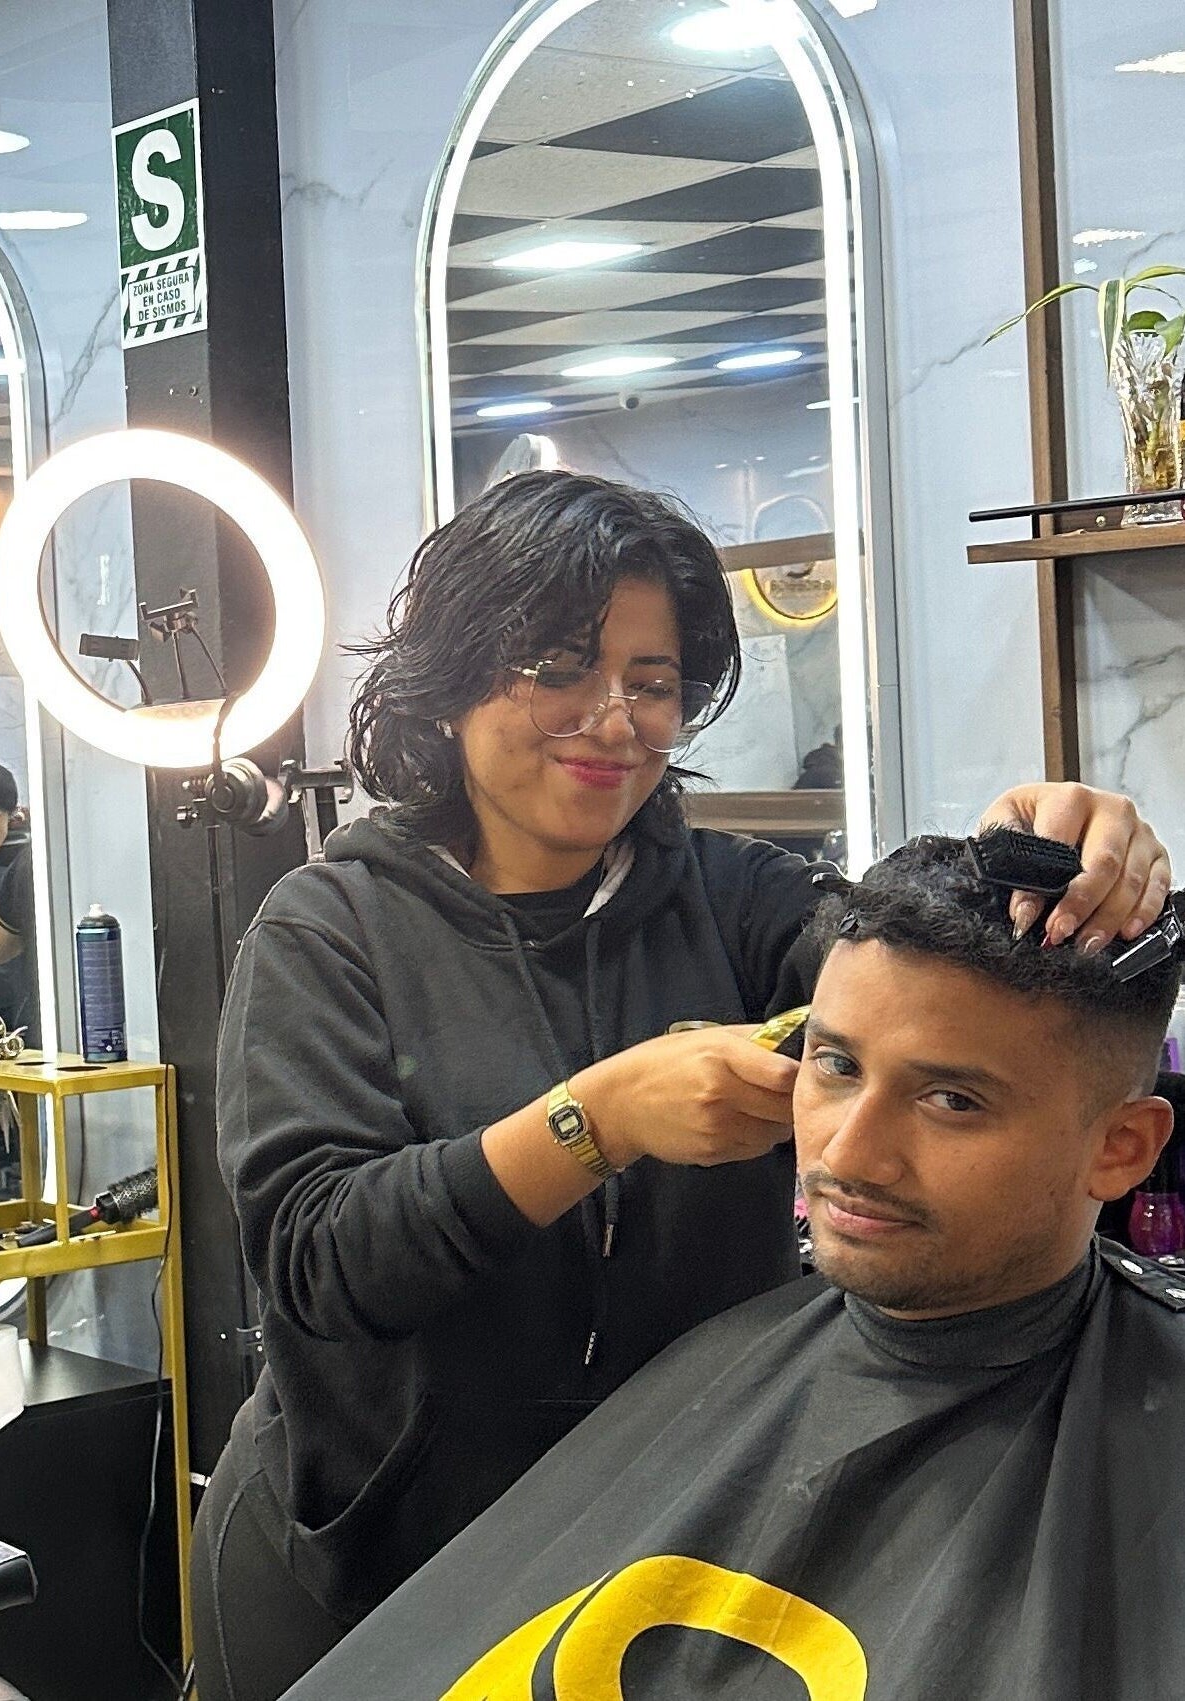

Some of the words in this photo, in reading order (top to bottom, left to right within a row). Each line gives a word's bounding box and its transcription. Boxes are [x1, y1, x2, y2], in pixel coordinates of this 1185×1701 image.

[131, 128, 185, 252] S
[133, 281, 154, 296] ZONA
[156, 271, 190, 290] SEGURA
[143, 294, 153, 307] EN
[157, 288, 180, 303] CASO
[138, 308, 149, 321] DE
[153, 300, 186, 318] SISMOS
